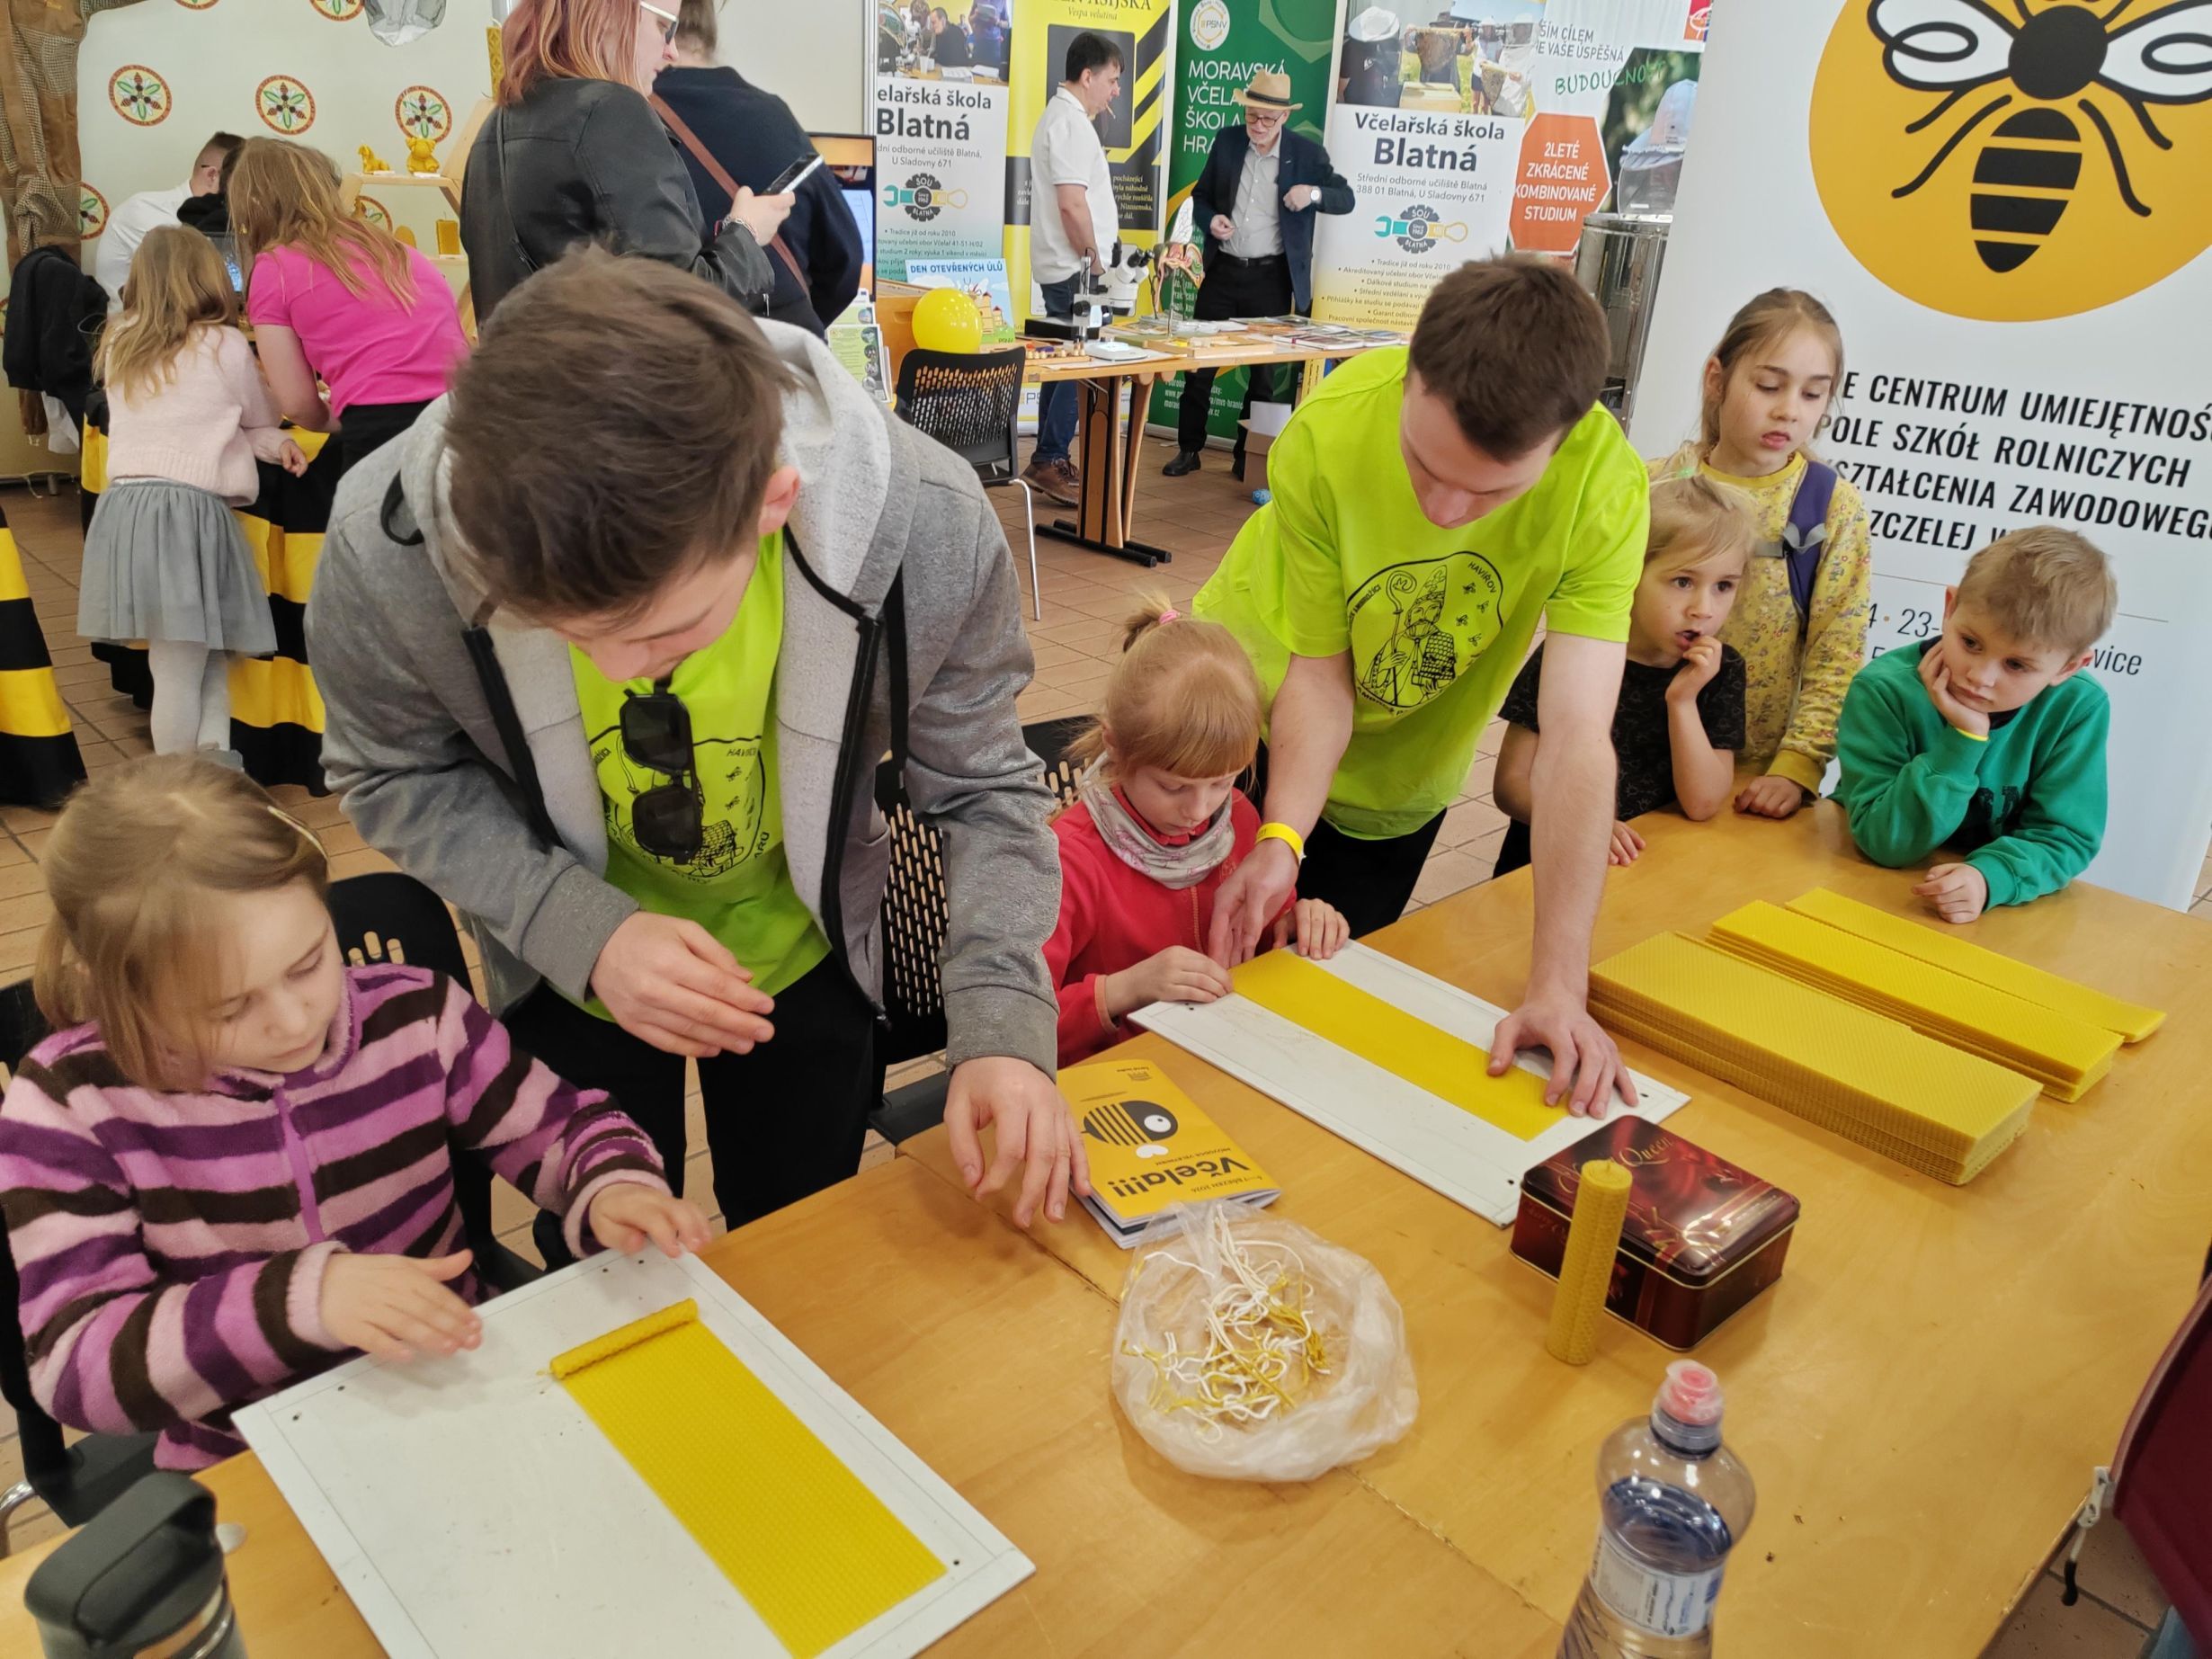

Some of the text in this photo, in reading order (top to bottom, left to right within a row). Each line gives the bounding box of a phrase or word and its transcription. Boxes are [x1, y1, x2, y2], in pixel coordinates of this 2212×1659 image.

[1561, 23, 1594, 43] CÍLEM
[1548, 40, 1574, 58] VAŠE
[946, 89, 992, 109] škola
[877, 107, 970, 141] Blatná
[1354, 111, 1505, 140] Včelařská škola
[891, 145, 926, 156] odborné
[927, 146, 955, 157] učiliště
[1373, 137, 1477, 173] Blatná
[1544, 139, 1581, 159] 2LETÉ
[892, 156, 952, 170] U Sladovny 671
[1526, 159, 1590, 181] ZKRÁCENÉ
[915, 177, 933, 187] SOU
[1356, 173, 1488, 192] Střední odborné učiliště Blatná
[1356, 184, 1485, 203] 388 01 Blatná, U Sladovny 671
[1515, 183, 1597, 202] KOMBINOVANÉ
[1412, 209, 1431, 219] SOU
[1524, 205, 1577, 222] STUDIUM
[889, 227, 910, 236] Tradice
[941, 229, 957, 237] 2010
[910, 265, 928, 274] DEN
[930, 261, 985, 273] OTEVŘENÝCH
[1342, 267, 1386, 277] Akreditovaný
[1386, 269, 1408, 278] učební
[1408, 271, 1423, 279] obor
[1377, 258, 1451, 271] Tradice již od roku 2010
[1359, 286, 1382, 296] Střední
[1382, 289, 1409, 298] vzdělání
[1366, 277, 1393, 287] Dálkové
[1393, 280, 1419, 289] studium
[1326, 295, 1353, 305] Přihlášky
[1363, 298, 1384, 307] studiu
[1392, 299, 1421, 309] podávají
[1328, 314, 1355, 323] Pracovní
[1355, 317, 1389, 326] společnost
[1372, 309, 1395, 317] Garant
[1869, 373, 2009, 417] CENTRUM
[2020, 391, 2212, 442] UMIEJĘTNOŚ
[1892, 421, 1982, 461] SZKÓŁ
[1993, 435, 2192, 488] ROLNICZYCH
[1829, 459, 2212, 540] SZTAŁCENIA ZAWODOWEG
[1618, 1136, 1673, 1168] Queen
[1107, 1156, 1251, 1199] Včela!!!
